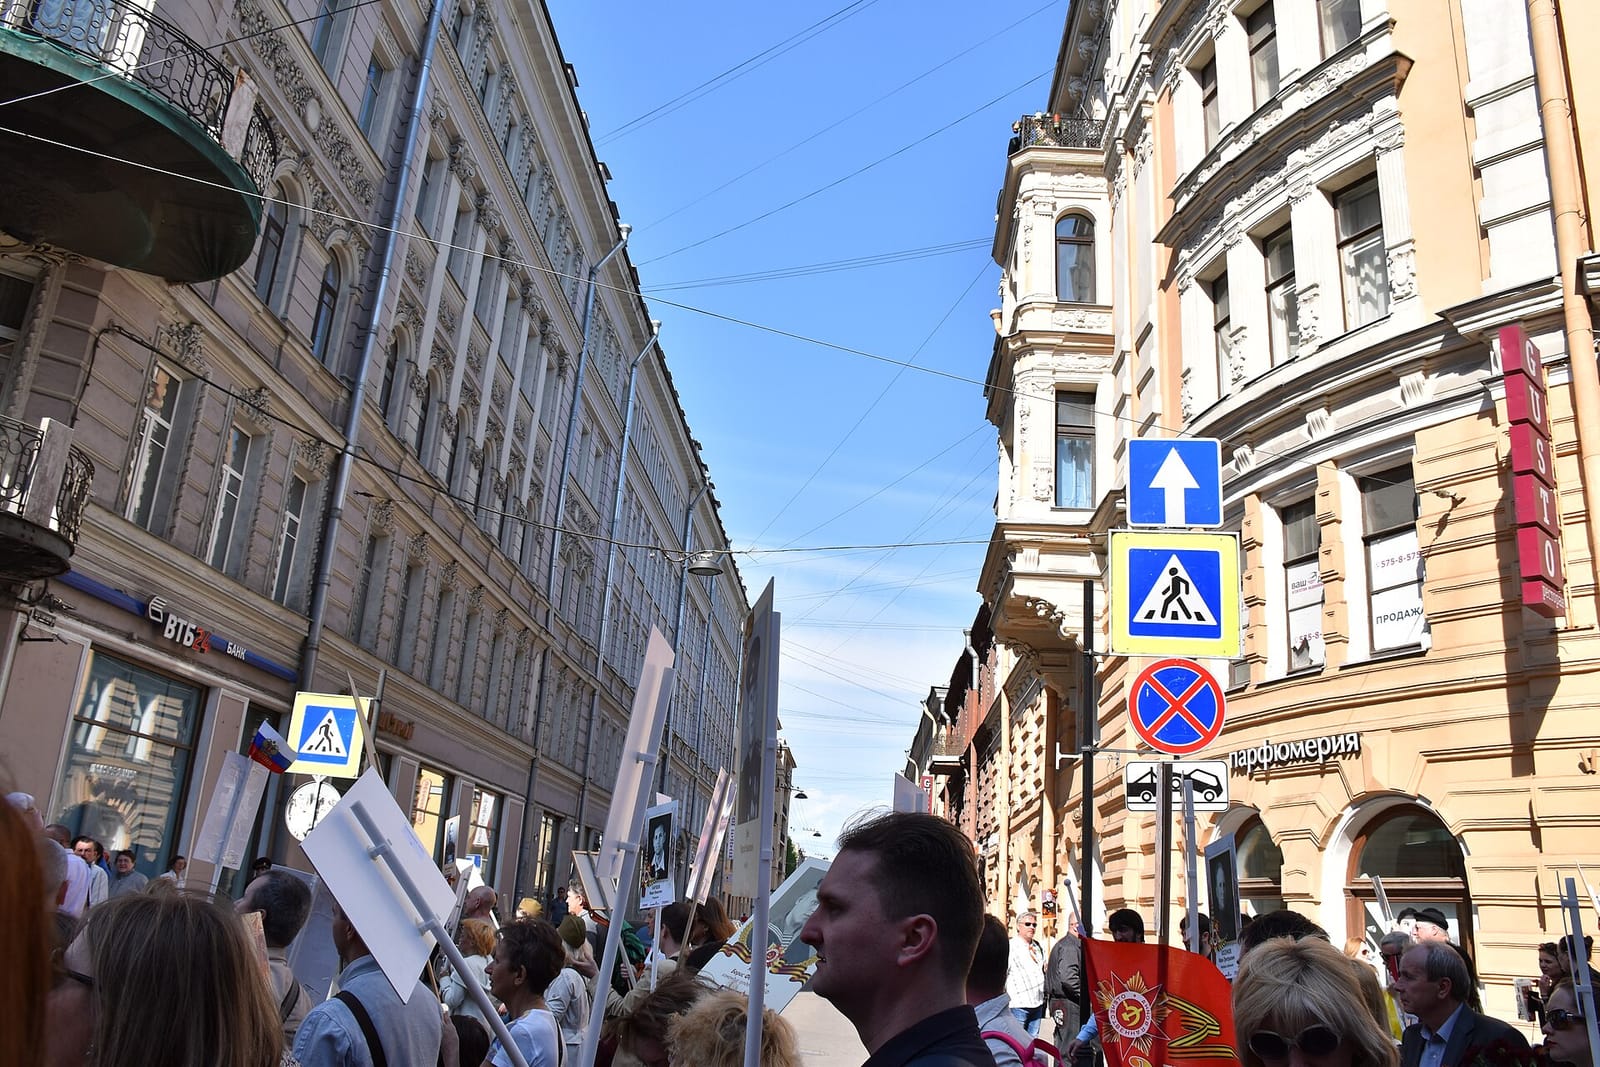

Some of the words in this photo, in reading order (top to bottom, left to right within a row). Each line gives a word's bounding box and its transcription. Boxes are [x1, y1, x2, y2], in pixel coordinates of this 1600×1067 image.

[1525, 339, 1556, 579] GUSTO
[163, 613, 211, 654] ВТБ24
[226, 641, 247, 661] БАНК
[1228, 732, 1360, 772] парфюмерия
